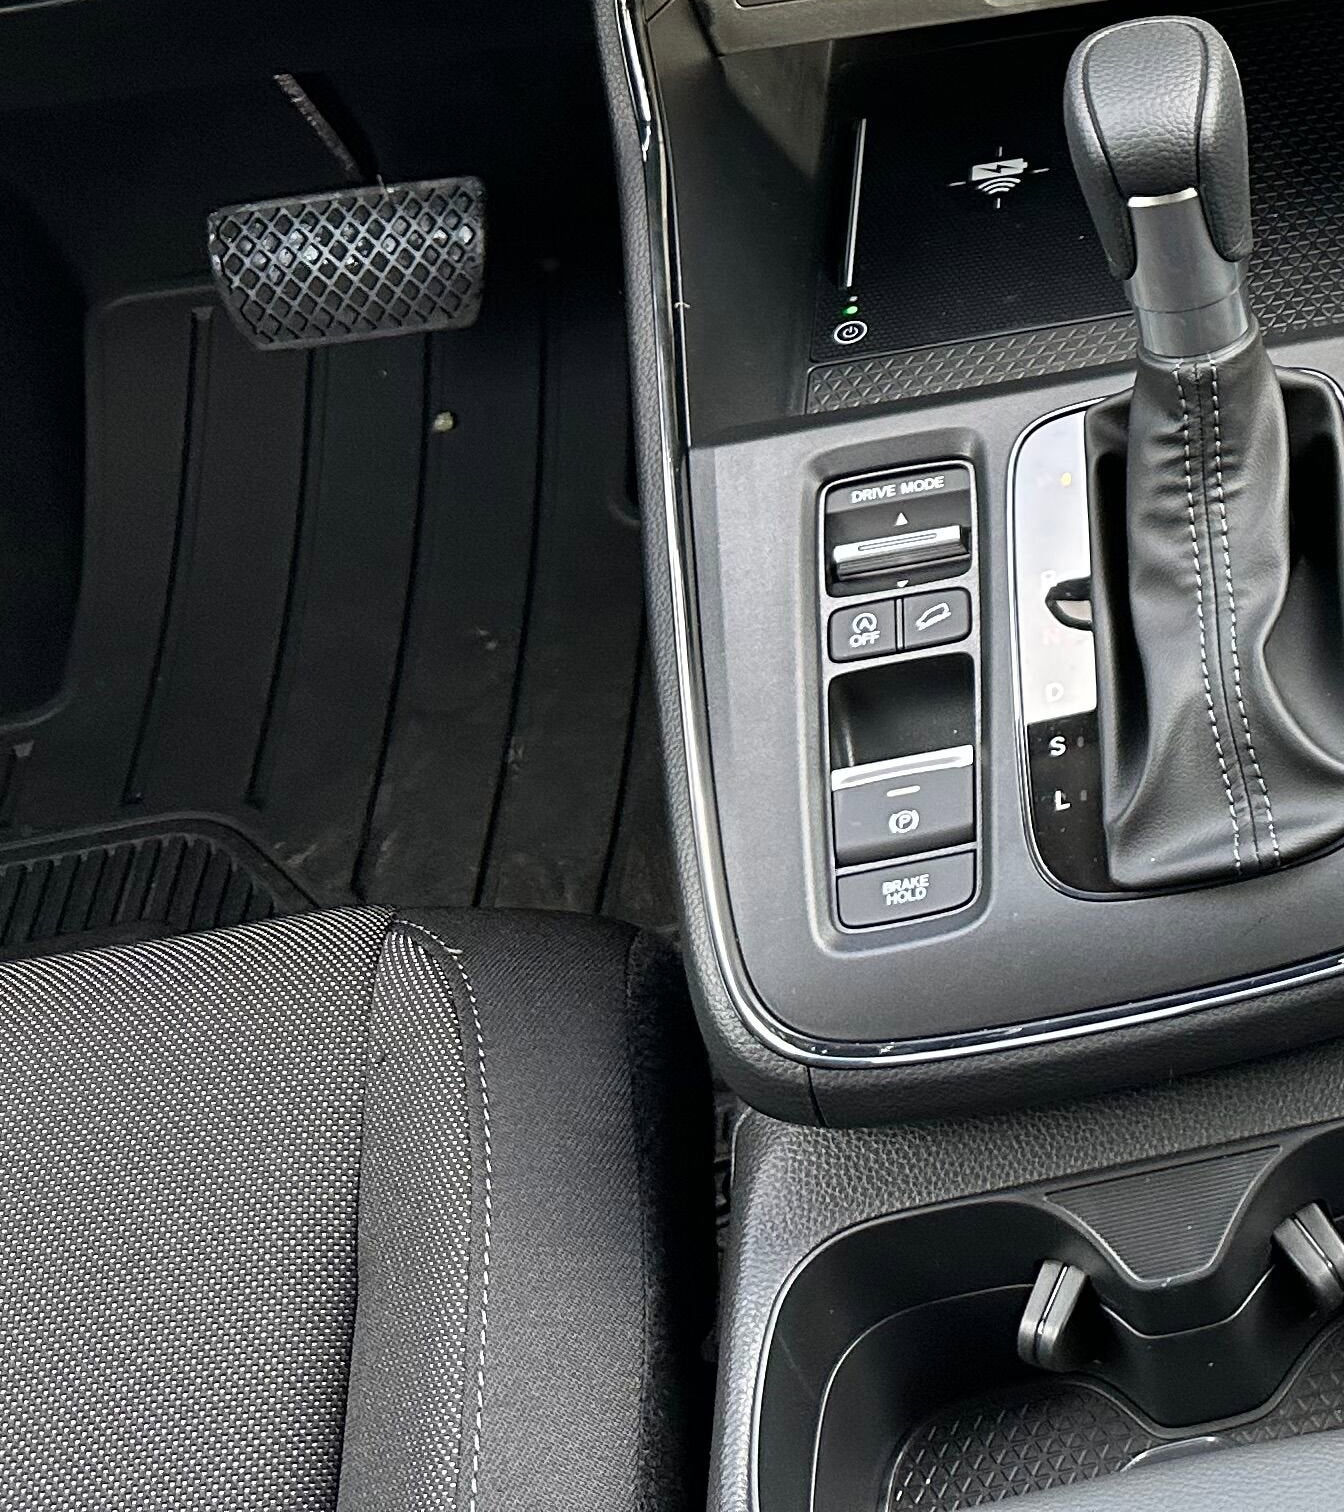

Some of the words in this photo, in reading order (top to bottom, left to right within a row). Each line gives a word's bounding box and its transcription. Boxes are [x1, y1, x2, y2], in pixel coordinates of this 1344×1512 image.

[851, 484, 896, 503] DRIVE
[900, 476, 944, 494] MODE
[850, 631, 881, 648] OFF
[1050, 737, 1066, 755] S
[1054, 790, 1071, 811] L
[882, 874, 929, 895] BRAKE
[886, 886, 926, 905] HOLD
